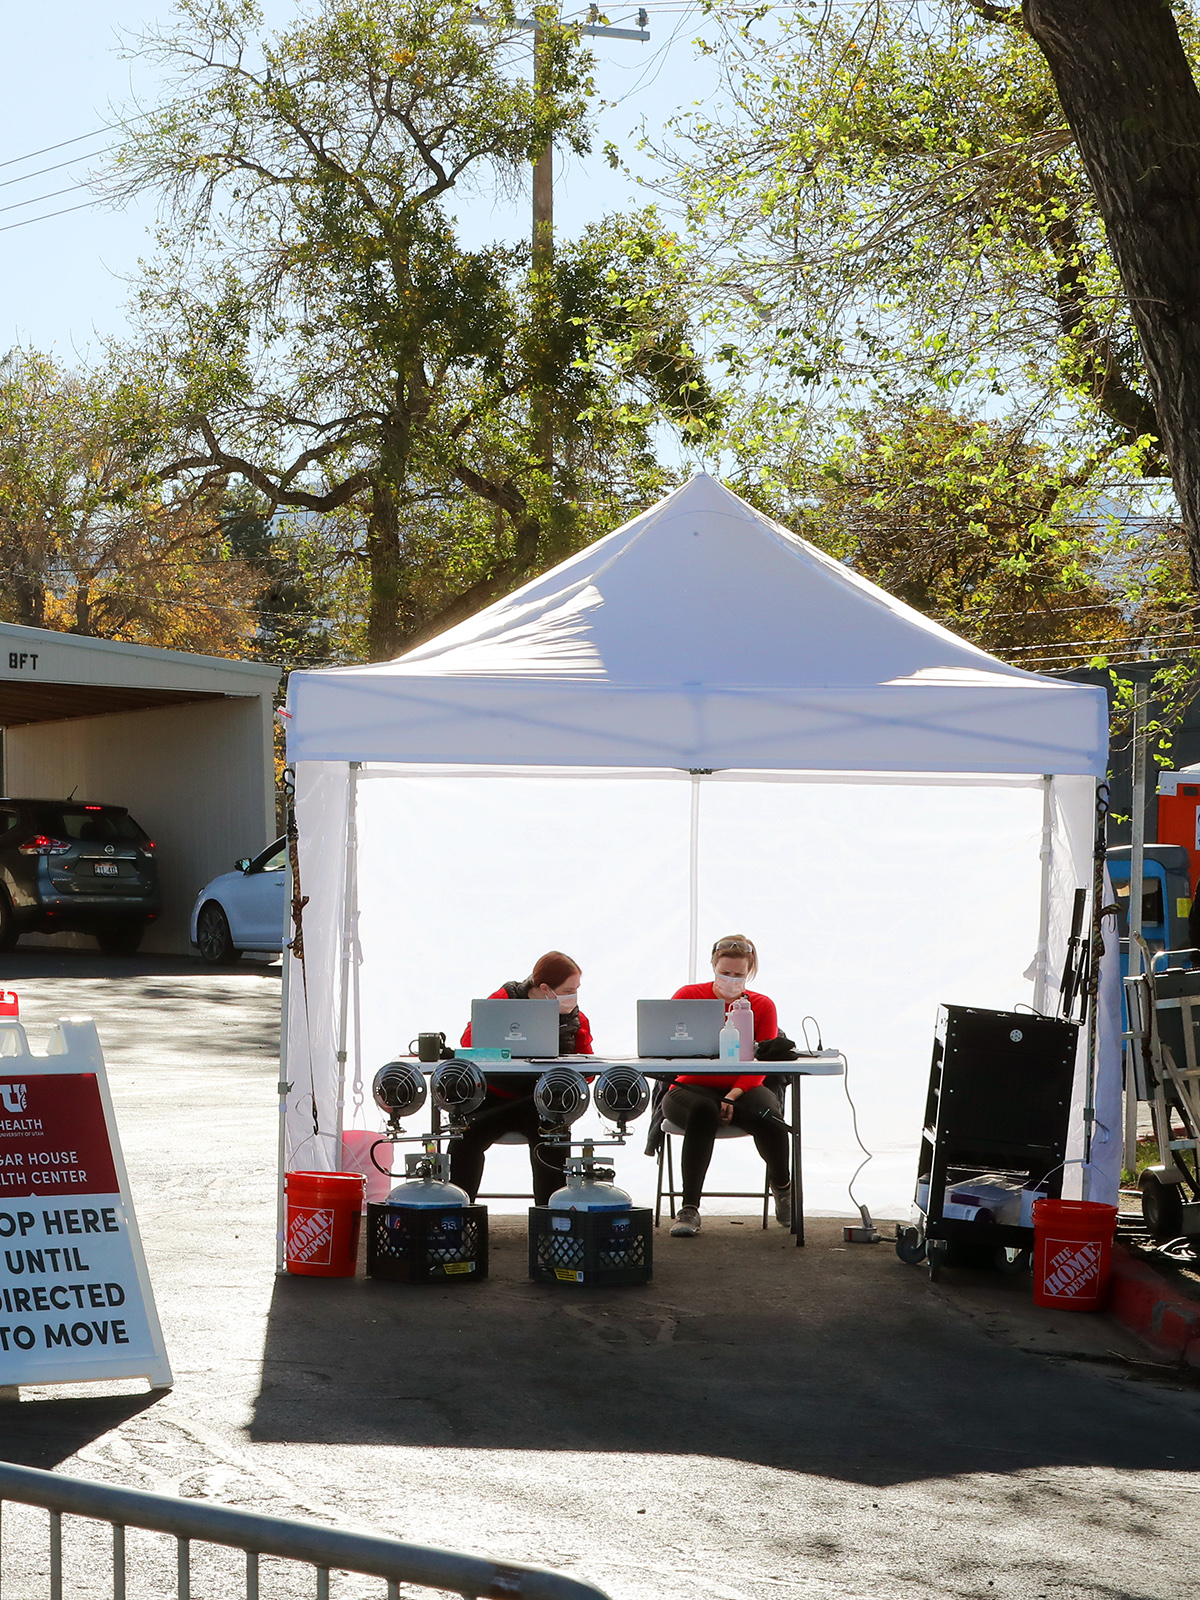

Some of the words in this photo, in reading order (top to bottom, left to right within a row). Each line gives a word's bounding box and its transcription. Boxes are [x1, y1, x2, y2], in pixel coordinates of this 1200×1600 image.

[28, 1151, 79, 1165] HOUSE
[31, 1170, 88, 1184] CENTER
[42, 1207, 120, 1235] HERE
[286, 1209, 333, 1260] HOME
[289, 1212, 307, 1234] THE
[298, 1229, 333, 1262] DEPOT
[1049, 1246, 1074, 1268] THE
[4, 1247, 90, 1275] UNTIL
[1044, 1242, 1101, 1296] HOME
[1063, 1262, 1099, 1298] DEPOT
[44, 1319, 130, 1349] MOVE
